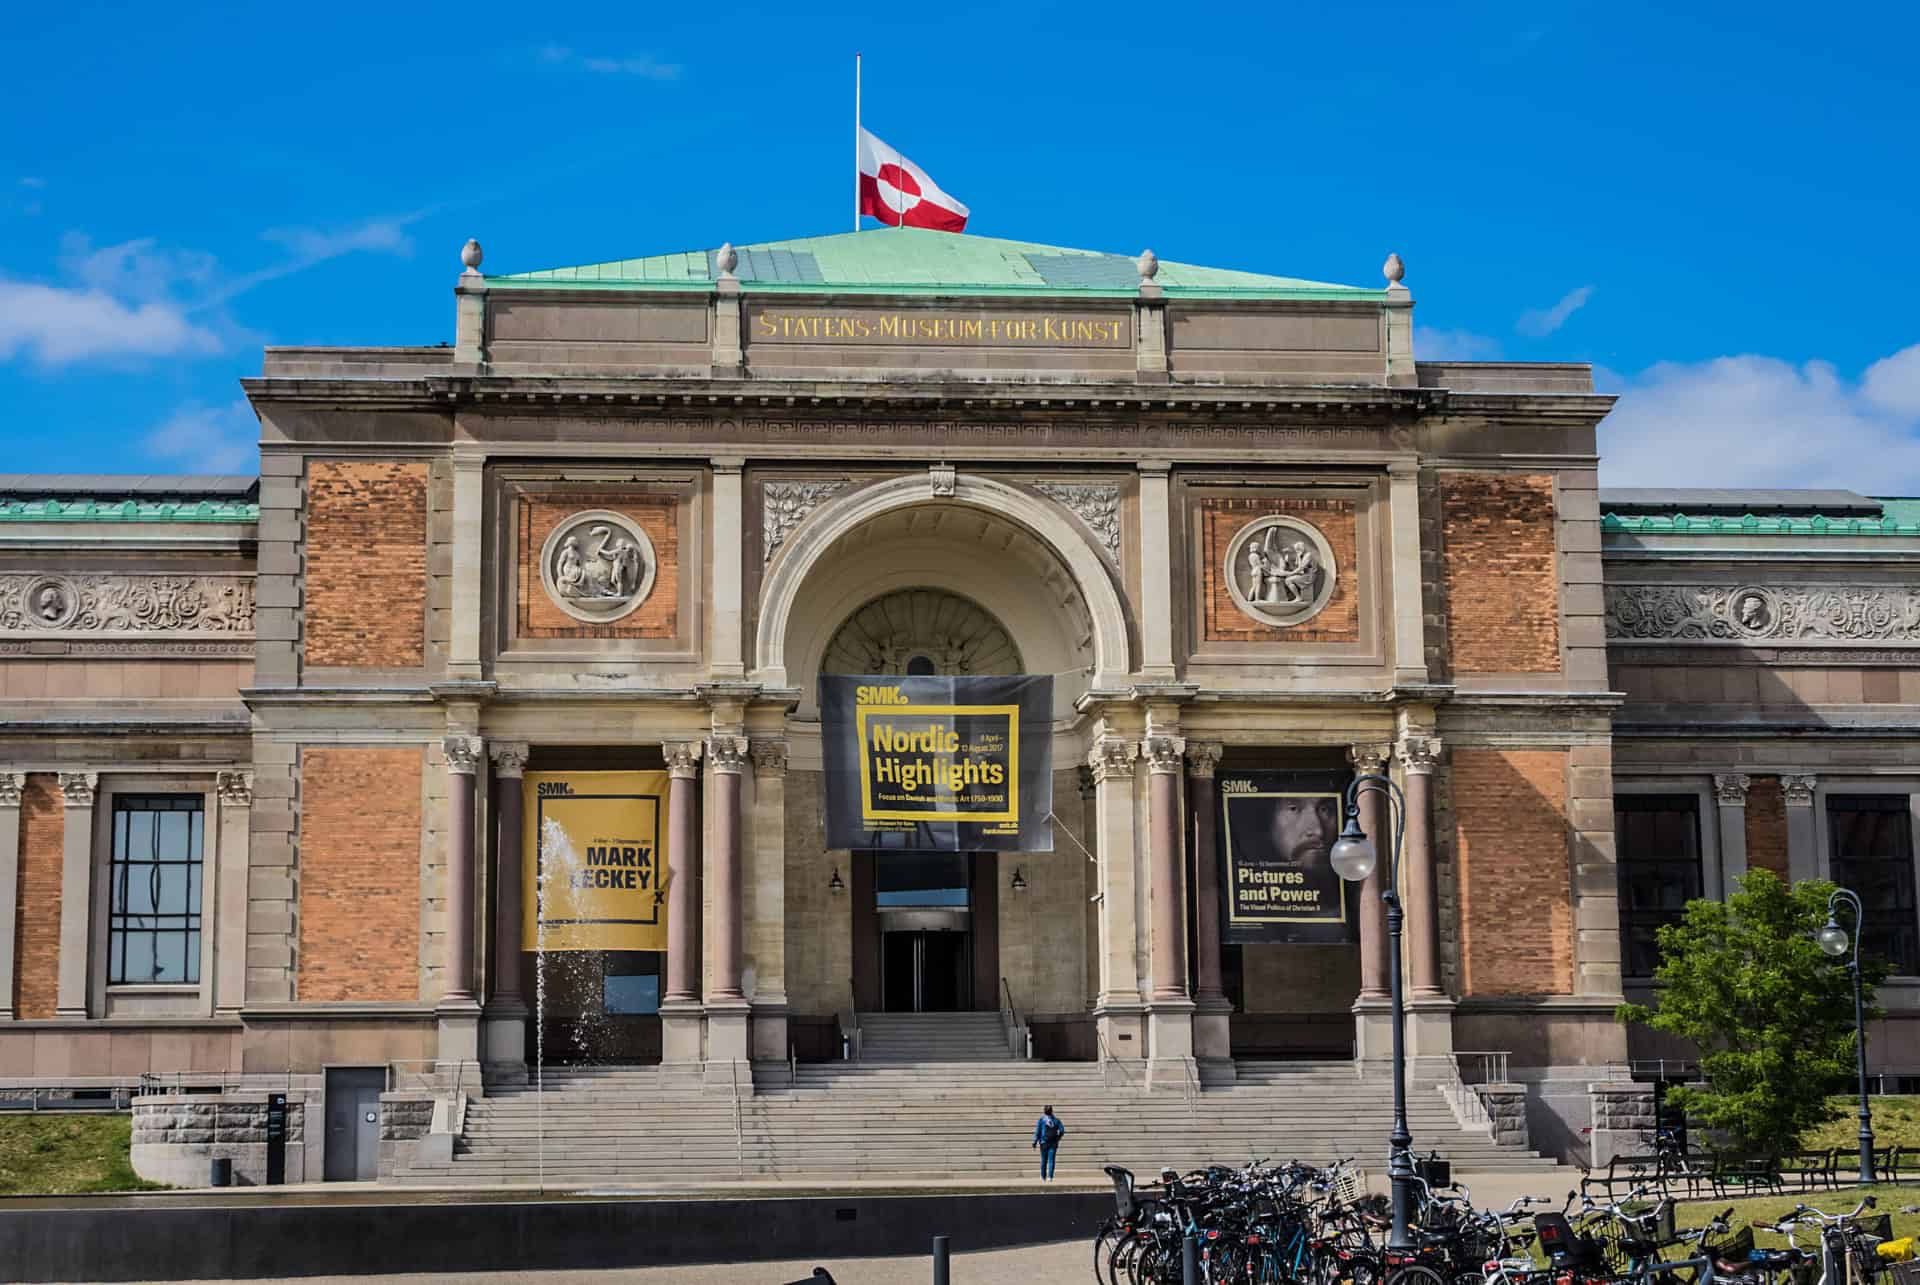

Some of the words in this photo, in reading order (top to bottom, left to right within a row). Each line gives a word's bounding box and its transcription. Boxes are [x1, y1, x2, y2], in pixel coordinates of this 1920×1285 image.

[879, 315, 982, 338] MUSEUM
[991, 319, 1036, 339] FOR
[1044, 318, 1123, 340] KUNST
[873, 724, 960, 752] Nordic
[875, 757, 1004, 791] Highlights
[587, 847, 651, 867] MARK
[1238, 868, 1304, 884] Pictures
[1239, 886, 1267, 901] and
[1270, 886, 1320, 901] Power
